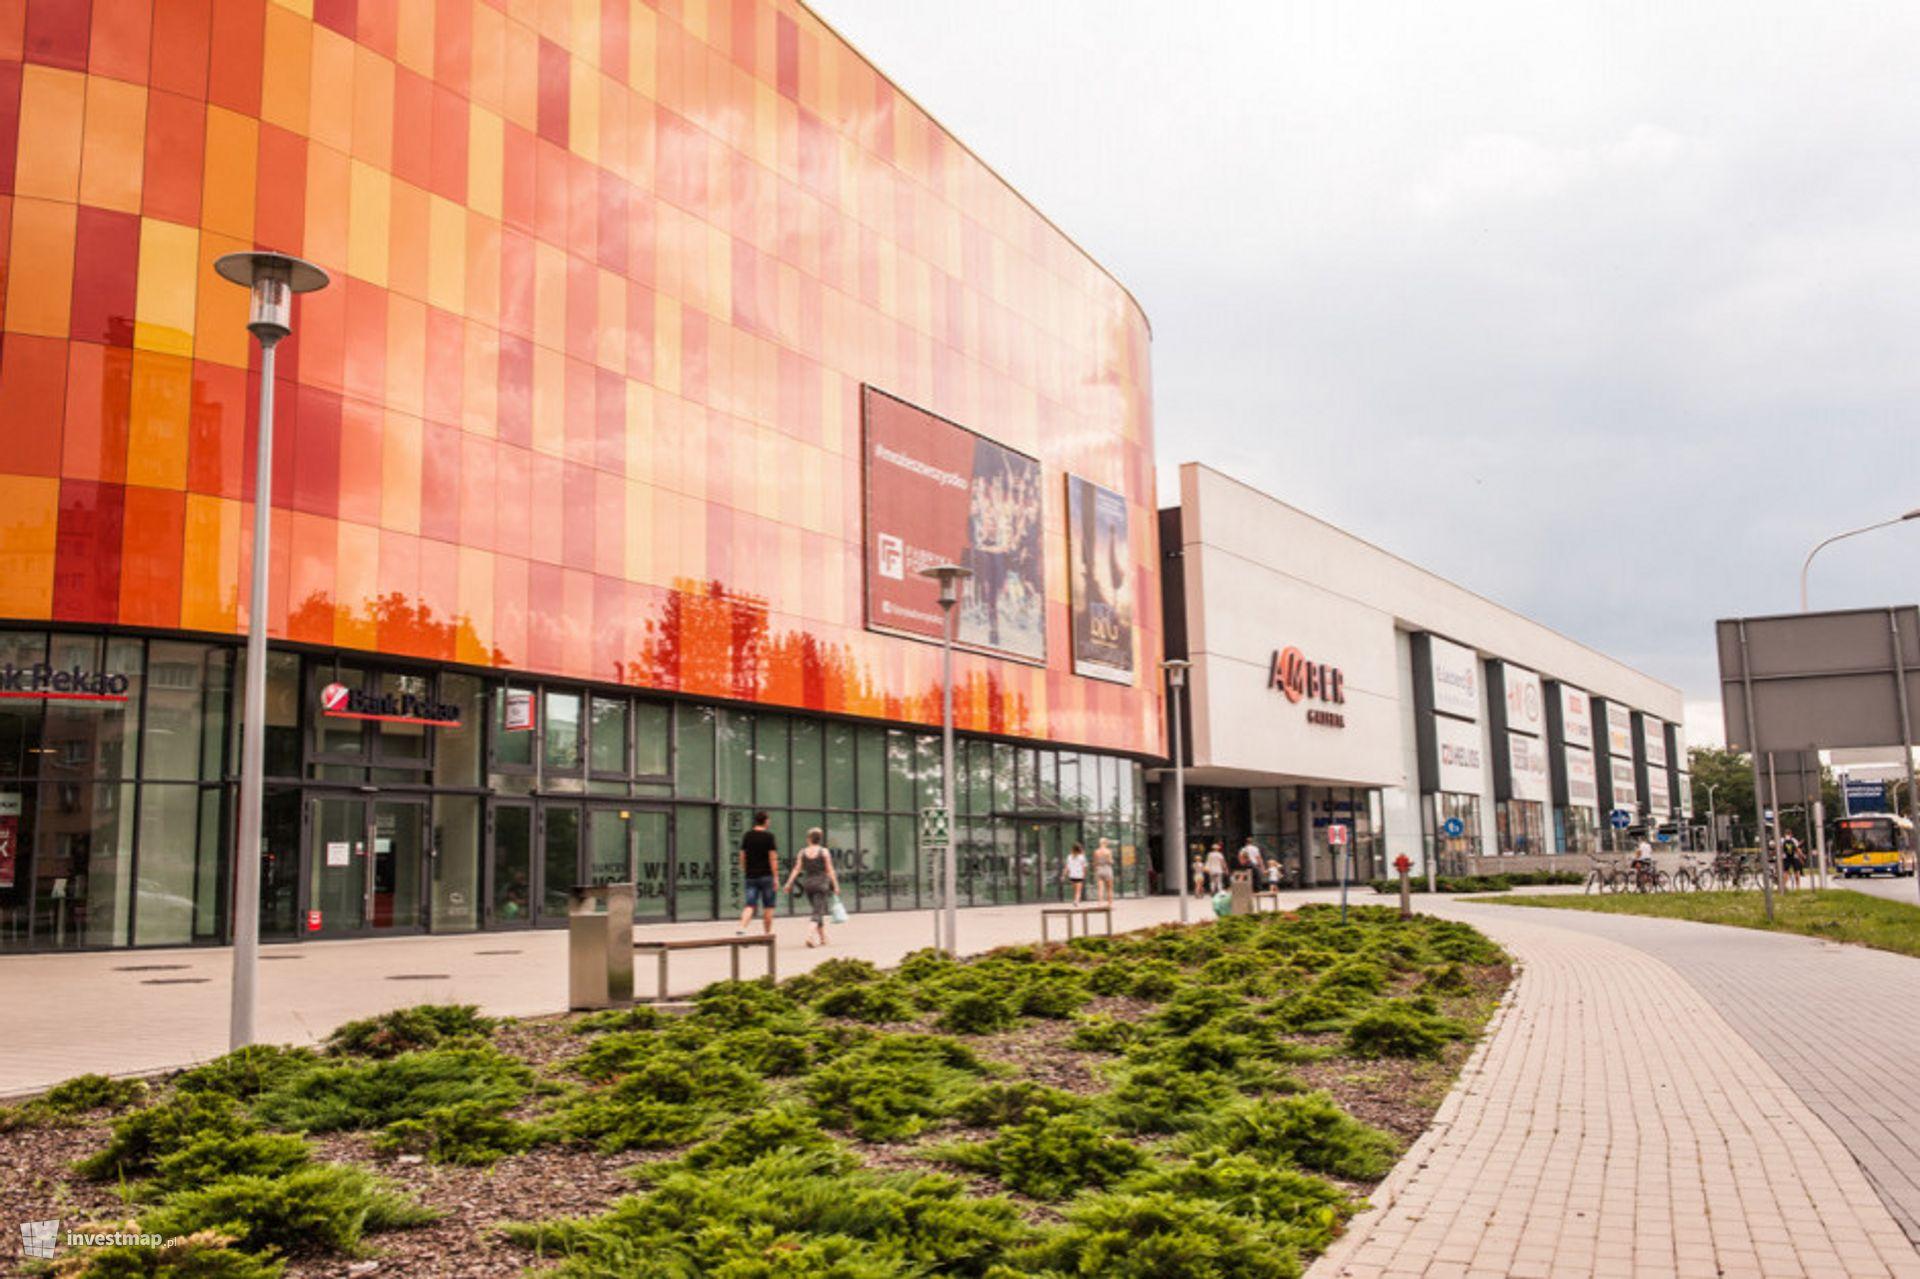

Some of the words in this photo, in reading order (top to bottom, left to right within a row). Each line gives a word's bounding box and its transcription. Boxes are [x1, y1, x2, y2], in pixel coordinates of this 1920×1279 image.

[32, 661, 129, 695] Pekao
[1267, 647, 1345, 704] AMBER
[349, 689, 399, 715] Bank
